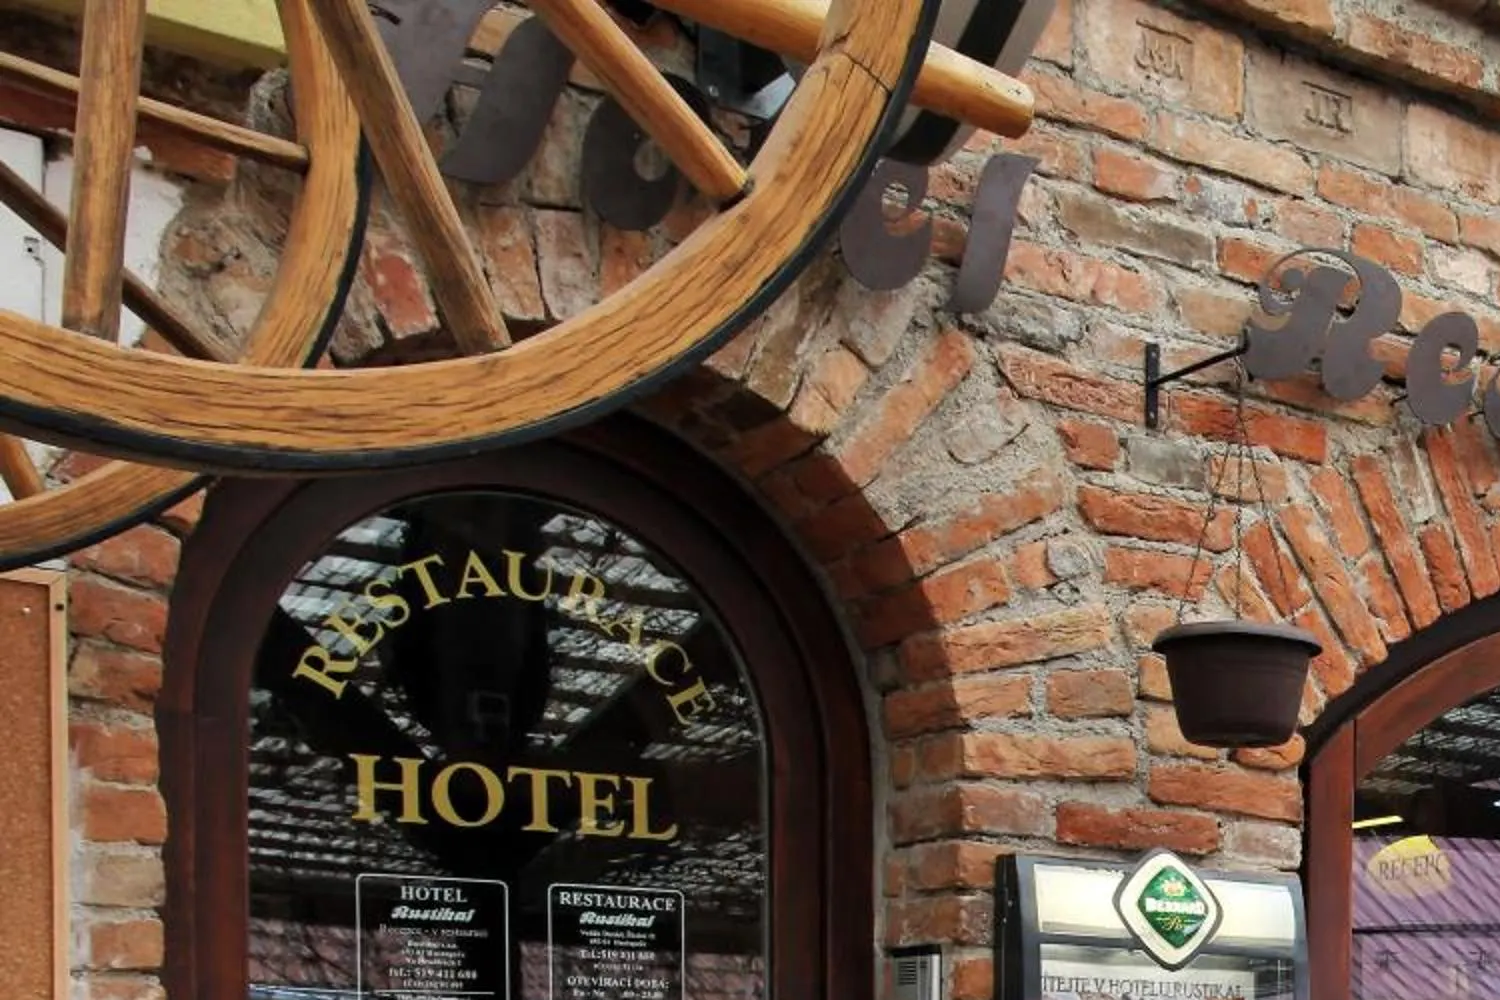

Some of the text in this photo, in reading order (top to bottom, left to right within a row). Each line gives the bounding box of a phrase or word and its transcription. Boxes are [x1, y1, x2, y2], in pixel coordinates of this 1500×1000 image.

[292, 549, 716, 726] RESTAURACE
[349, 752, 679, 842] HOTEL
[401, 885, 468, 902] HOTEL
[560, 891, 677, 912] RESTAURACE
